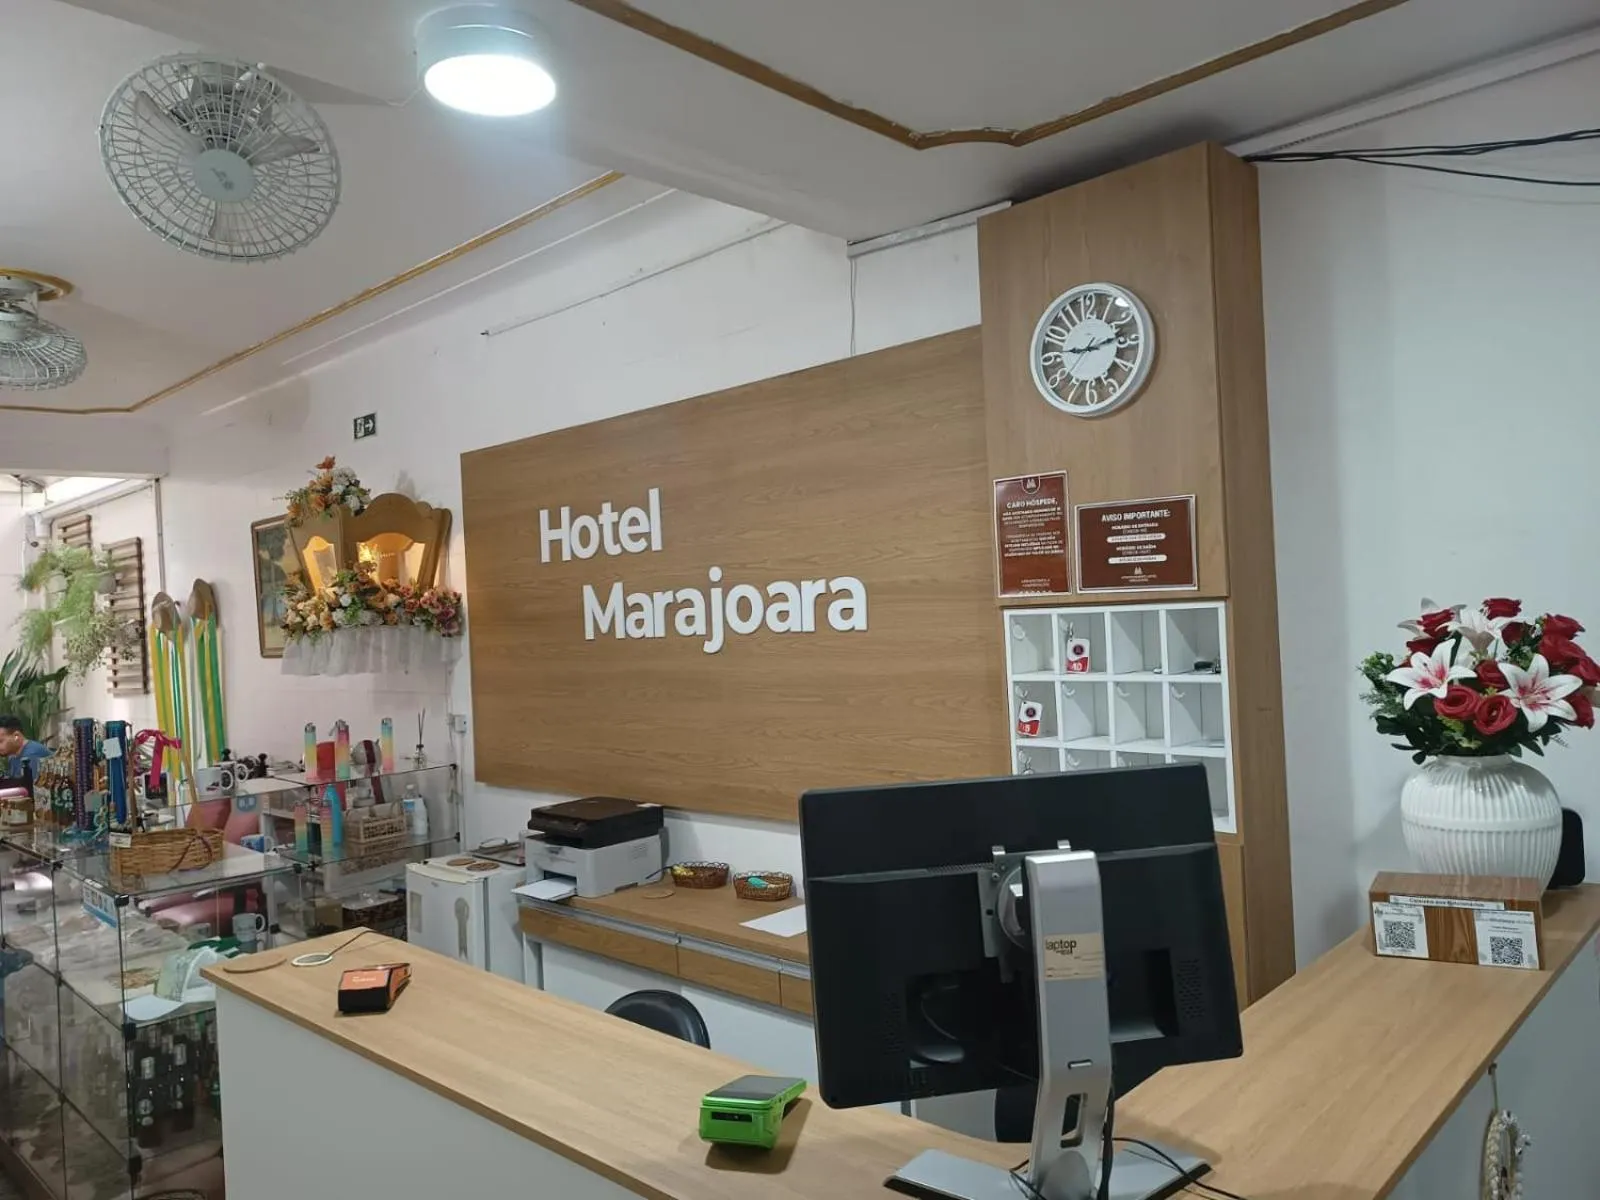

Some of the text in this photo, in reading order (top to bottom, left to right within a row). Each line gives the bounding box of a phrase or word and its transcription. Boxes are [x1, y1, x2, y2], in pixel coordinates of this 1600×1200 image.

[1057, 302, 1081, 331] 11
[1077, 292, 1097, 320] 12
[1101, 296, 1115, 322] 1
[1109, 310, 1134, 333] 2
[1045, 325, 1069, 347] 10
[1116, 333, 1140, 348] 3
[1041, 351, 1063, 366] 9
[1114, 357, 1136, 372] 4
[1048, 367, 1070, 389] 8
[1067, 376, 1080, 404] 7
[1100, 371, 1120, 397] 5
[1085, 379, 1098, 406] 6
[539, 487, 663, 563] Hotel
[1101, 513, 1123, 522] AVISO
[582, 566, 868, 655] Marajoara
[1045, 939, 1077, 954] laptop
